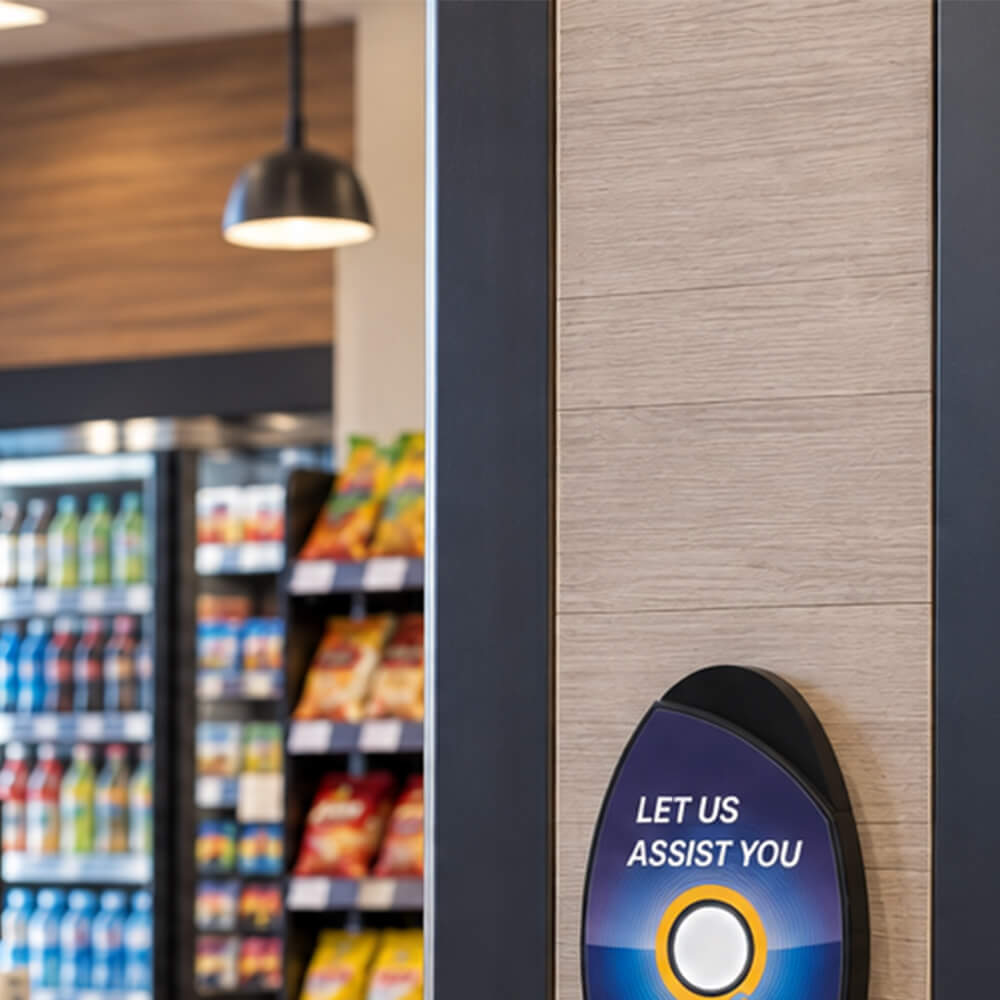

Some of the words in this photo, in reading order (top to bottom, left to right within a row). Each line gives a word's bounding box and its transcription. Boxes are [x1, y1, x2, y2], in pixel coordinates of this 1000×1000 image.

[636, 796, 692, 823] LET
[698, 796, 739, 823] US
[627, 840, 733, 867] ASSIST
[740, 840, 802, 867] YOU
